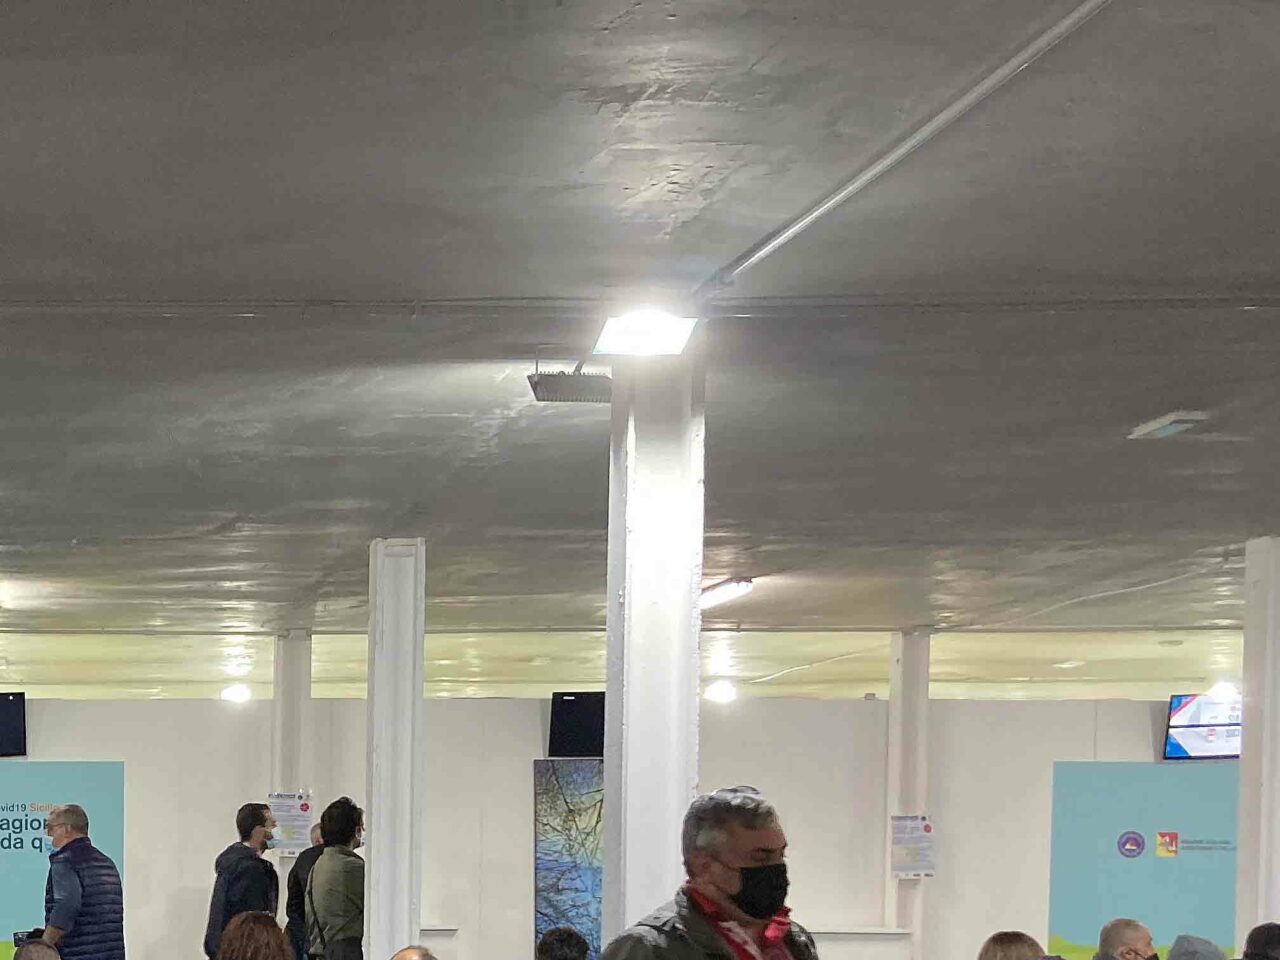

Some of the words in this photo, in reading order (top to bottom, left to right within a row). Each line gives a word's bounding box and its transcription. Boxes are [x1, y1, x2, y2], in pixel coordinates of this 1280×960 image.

[29, 803, 58, 812] Sicili
[0, 833, 24, 850] da
[31, 837, 43, 853] q
